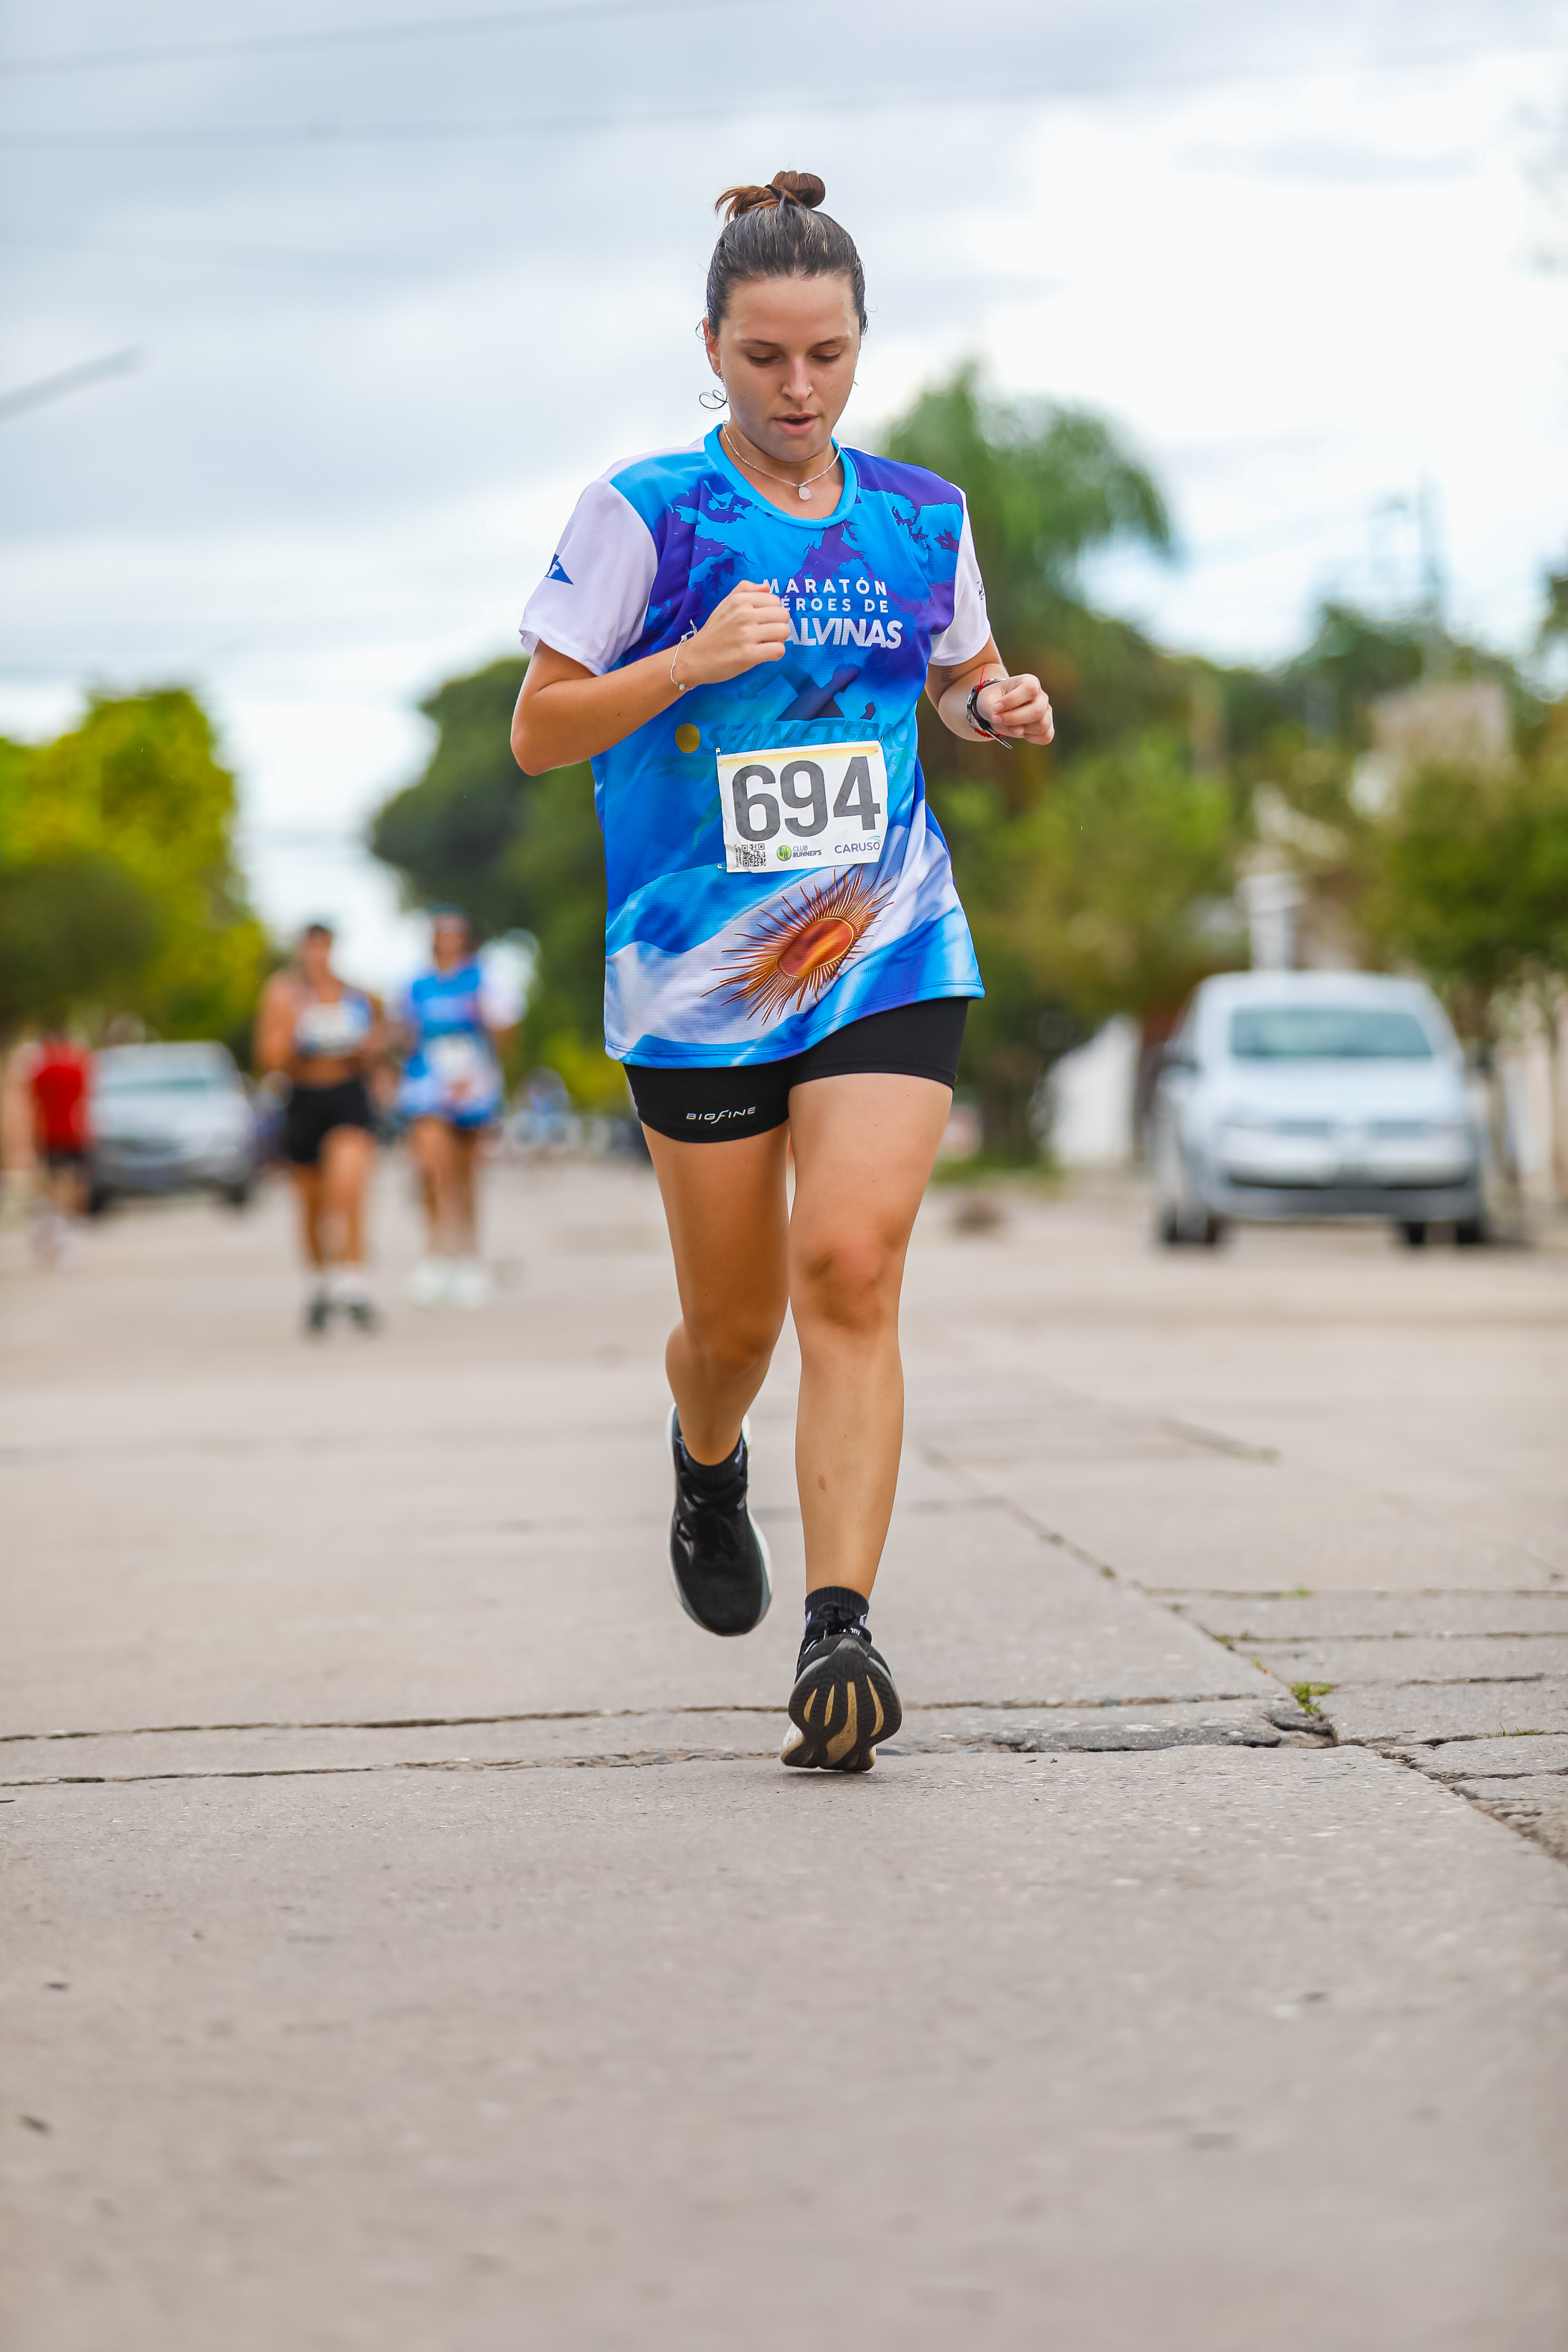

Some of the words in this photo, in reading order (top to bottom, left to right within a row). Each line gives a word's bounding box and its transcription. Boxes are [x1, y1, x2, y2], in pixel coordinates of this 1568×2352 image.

[763, 576, 887, 596] MARATÓN
[780, 595, 851, 612] ÉROES
[864, 599, 889, 613] DE
[786, 618, 904, 649] ALVINAS
[732, 756, 881, 841] 694
[792, 849, 822, 858] RUNNER'S
[834, 841, 880, 854] CARUSO
[686, 1106, 756, 1124] BIGFINE
